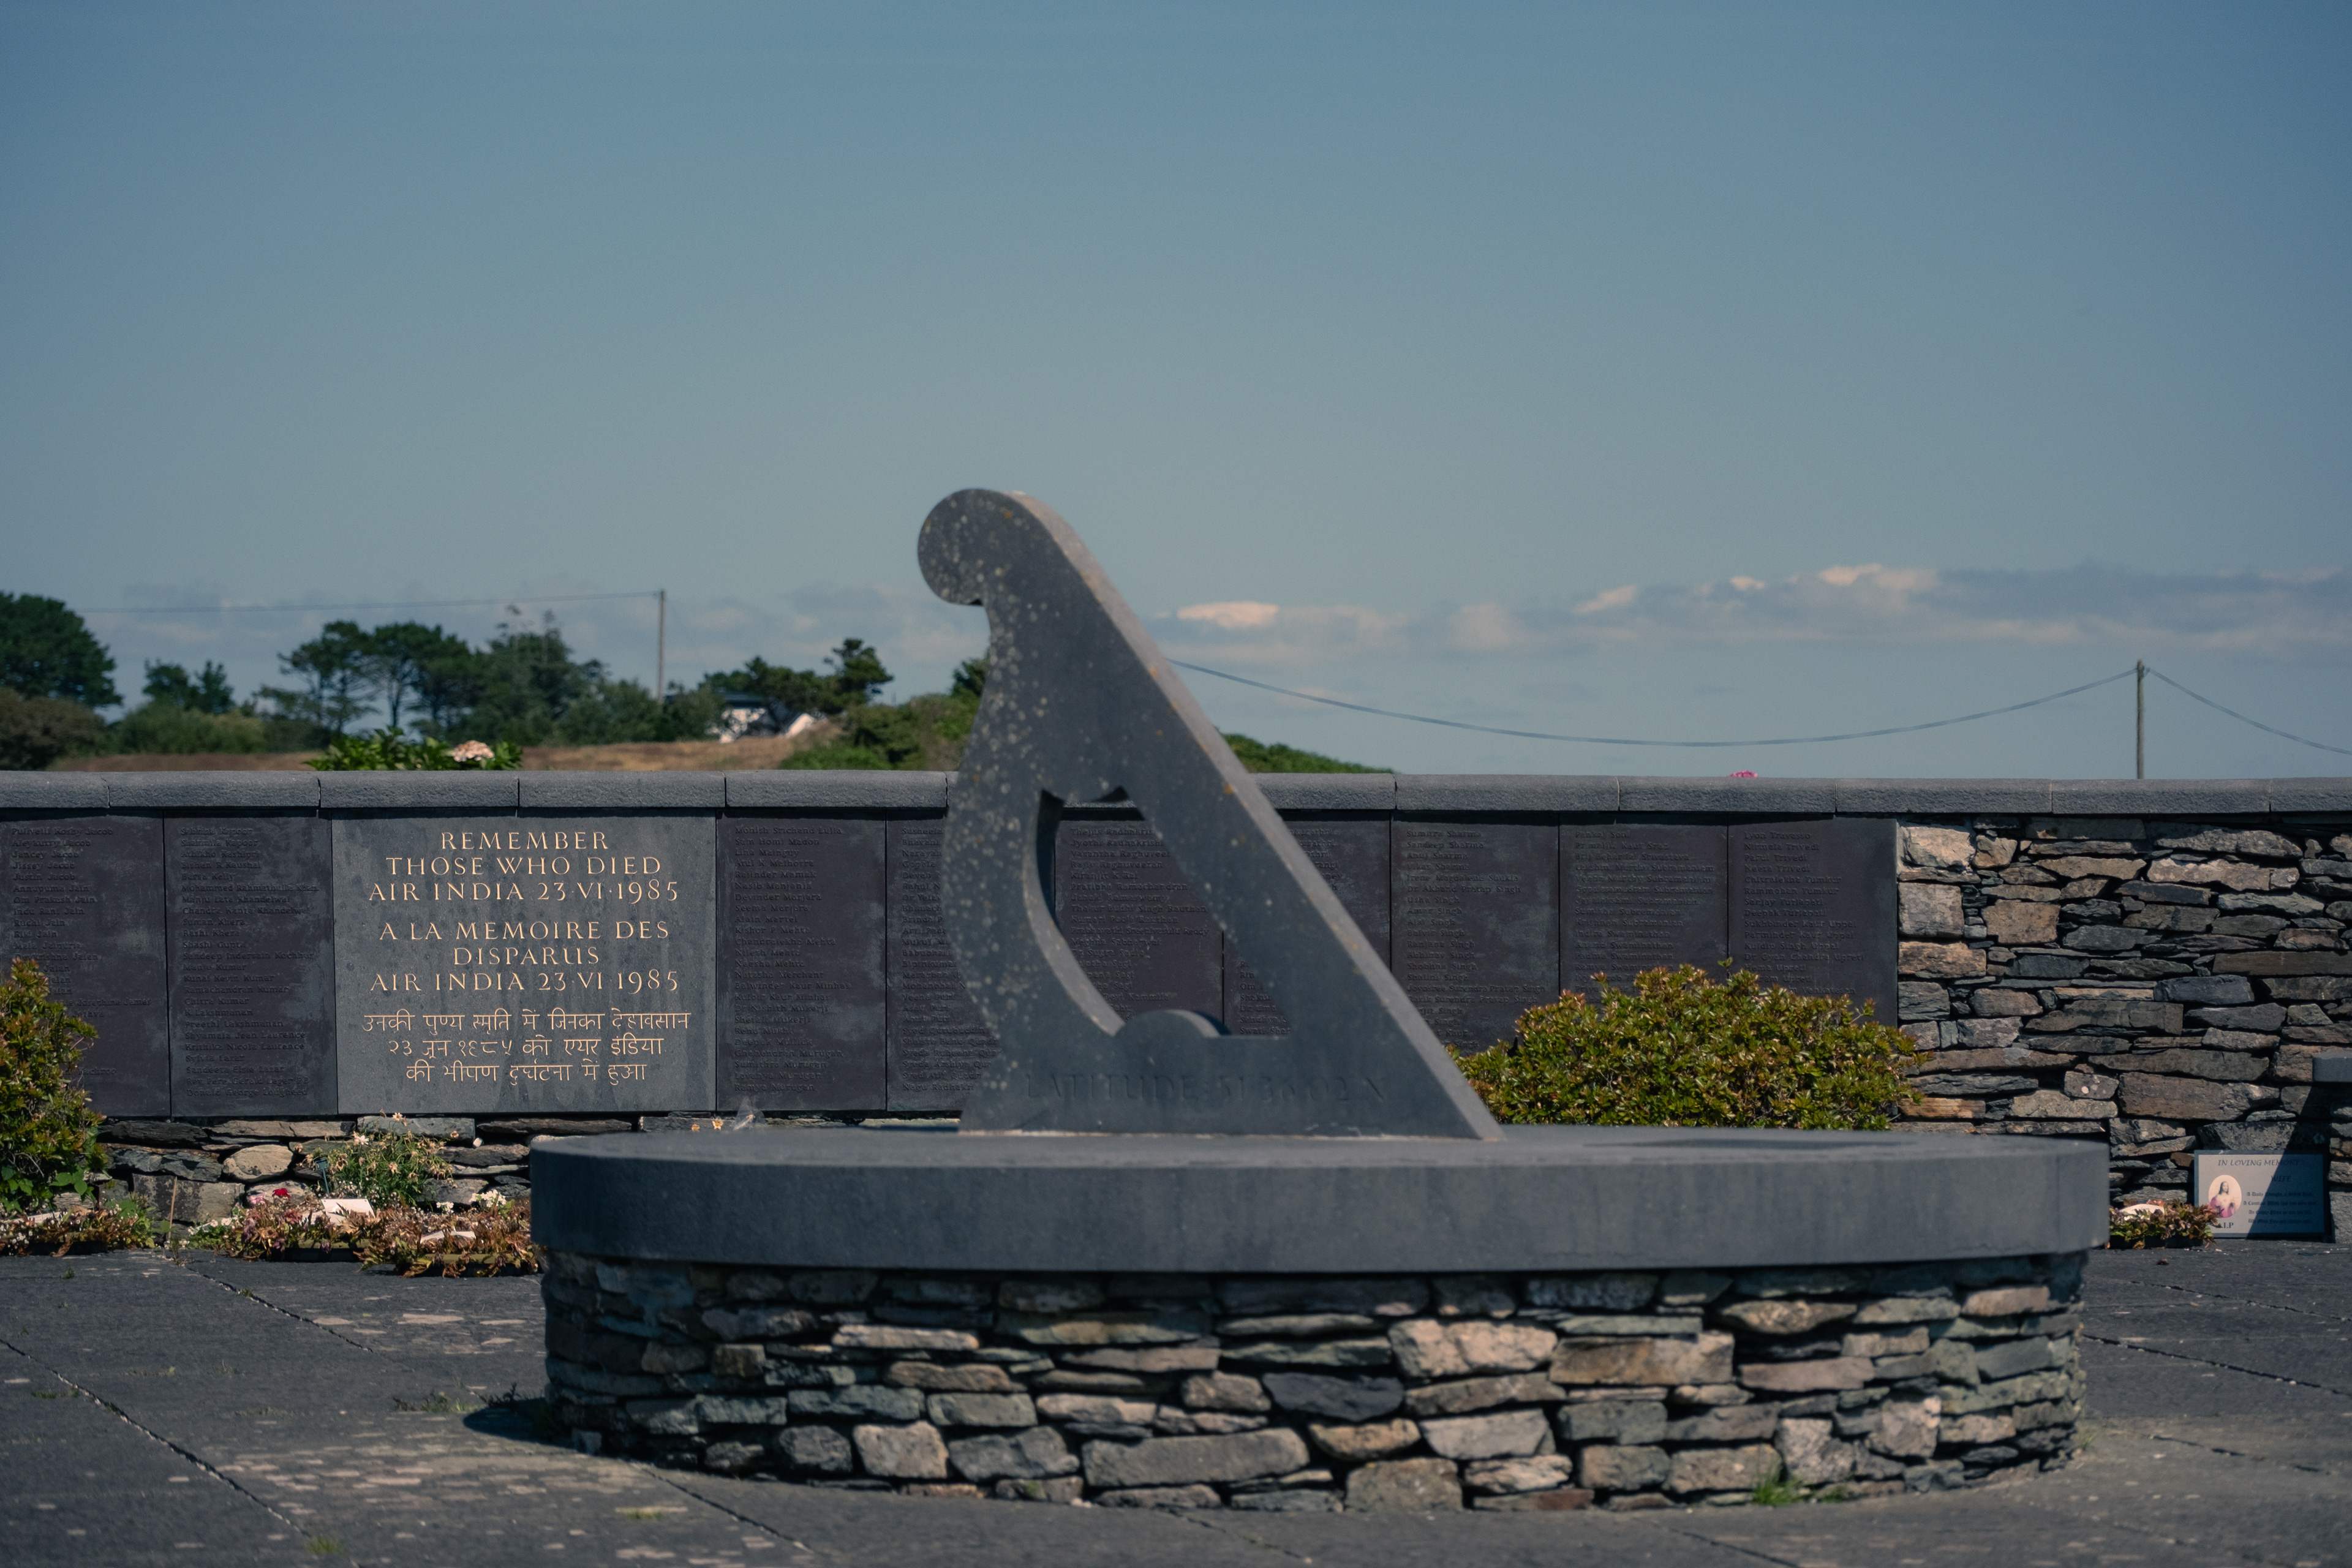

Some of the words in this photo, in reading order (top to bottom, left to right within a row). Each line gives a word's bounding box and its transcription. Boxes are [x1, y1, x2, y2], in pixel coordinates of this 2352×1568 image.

[441, 832, 609, 850] REMEMBER
[760, 848, 800, 857] Mainguy
[385, 857, 484, 875] THOSE
[496, 857, 570, 875] WHO
[587, 857, 661, 875] DIED
[368, 883, 420, 901] AIR
[434, 882, 524, 901] INDIA
[1496, 886, 1521, 894] Singh
[1435, 896, 1460, 905] Singh
[379, 922, 398, 940] A
[410, 922, 443, 941] LA
[456, 921, 601, 940] MEMOIRE
[616, 921, 668, 940] DES
[217, 941, 246, 950] Gupta
[454, 946, 599, 965] DISPARUS
[370, 973, 422, 992] AIR
[435, 972, 525, 991] INDIA
[617, 968, 678, 995] 1985
[362, 1008, 416, 1032] उनकी
[422, 1014, 466, 1036] पुण्य
[472, 1008, 513, 1035] स्मृति
[521, 1008, 541, 1030] में
[547, 1007, 606, 1030] जिनका
[421, 1040, 453, 1060] जून
[522, 1035, 552, 1056] को
[563, 1039, 602, 1056] एयर
[611, 1032, 665, 1055] इंडिया
[405, 1058, 436, 1082] की
[509, 1058, 574, 1087] दुर्घटना
[581, 1058, 600, 1081] में
[608, 1064, 648, 1086] हुआ
